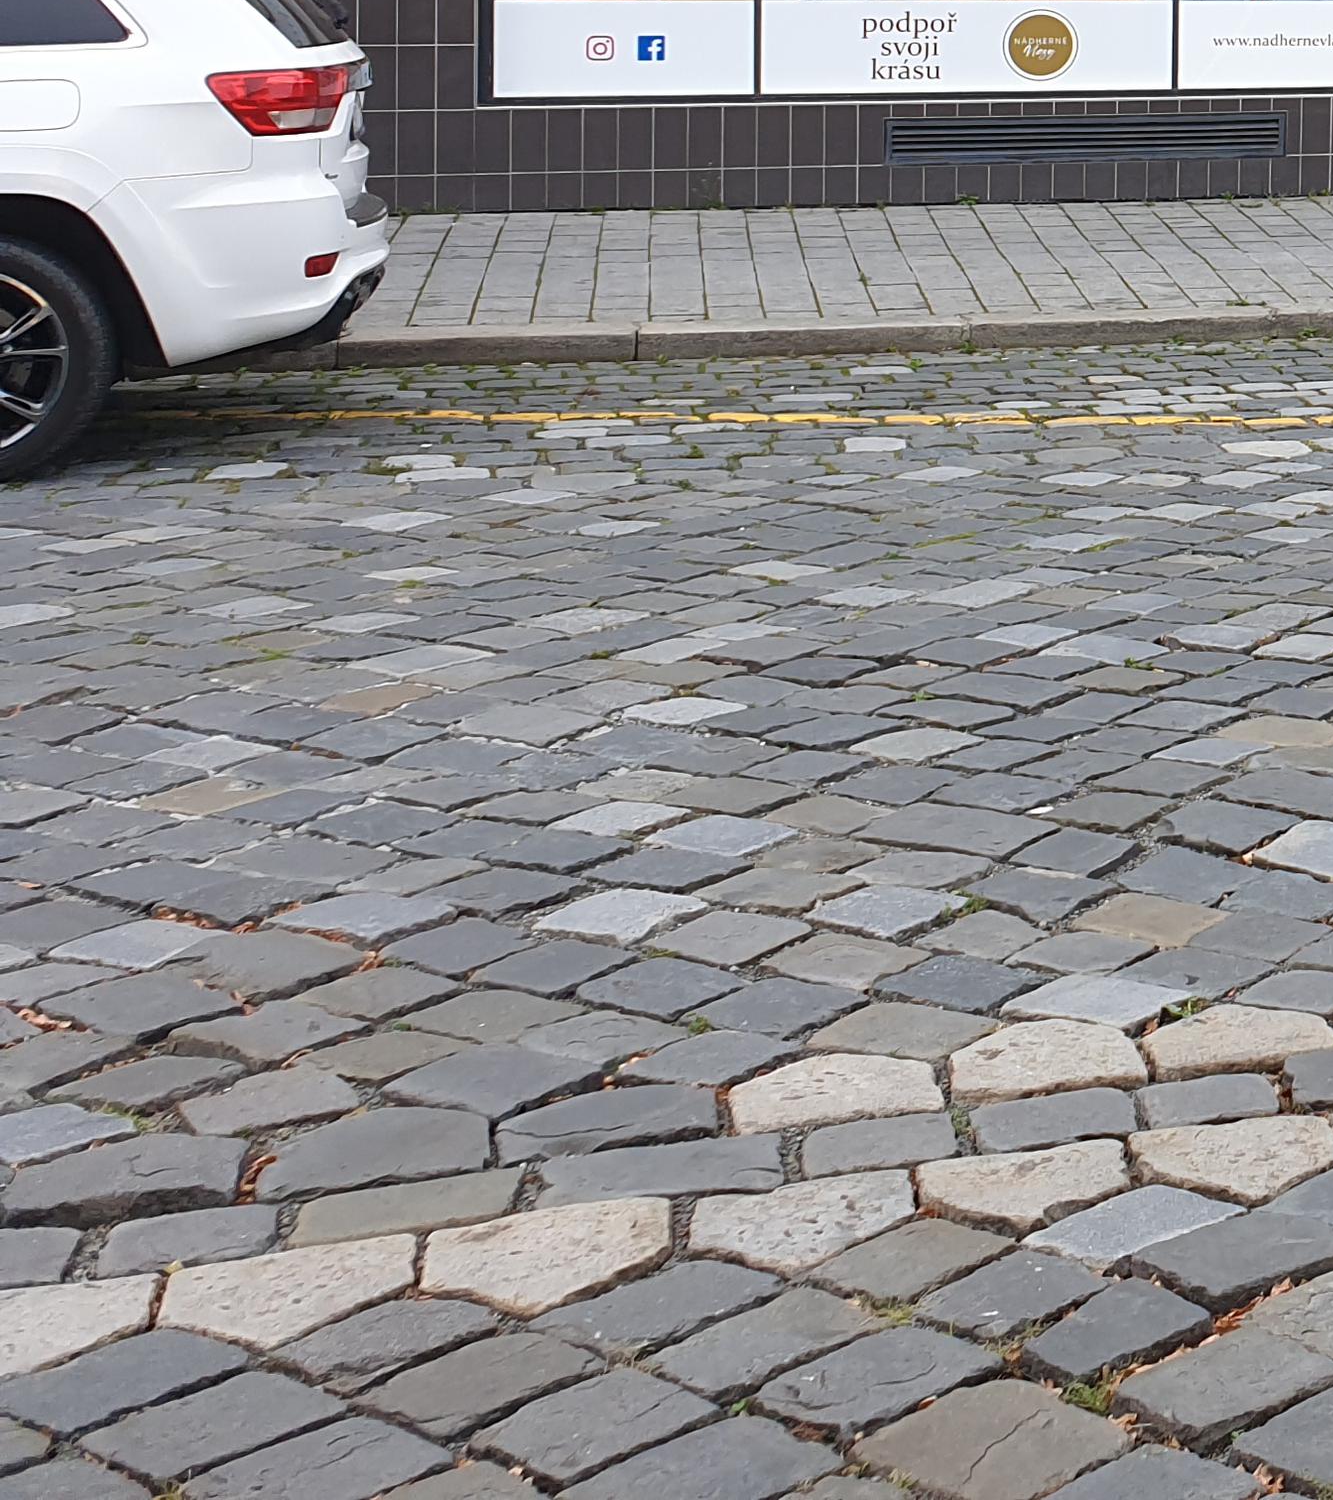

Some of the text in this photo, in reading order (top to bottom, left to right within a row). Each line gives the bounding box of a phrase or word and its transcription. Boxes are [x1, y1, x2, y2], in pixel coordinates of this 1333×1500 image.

[862, 11, 958, 39] podpoř
[880, 36, 939, 63] svoji
[870, 58, 941, 80] krásu
